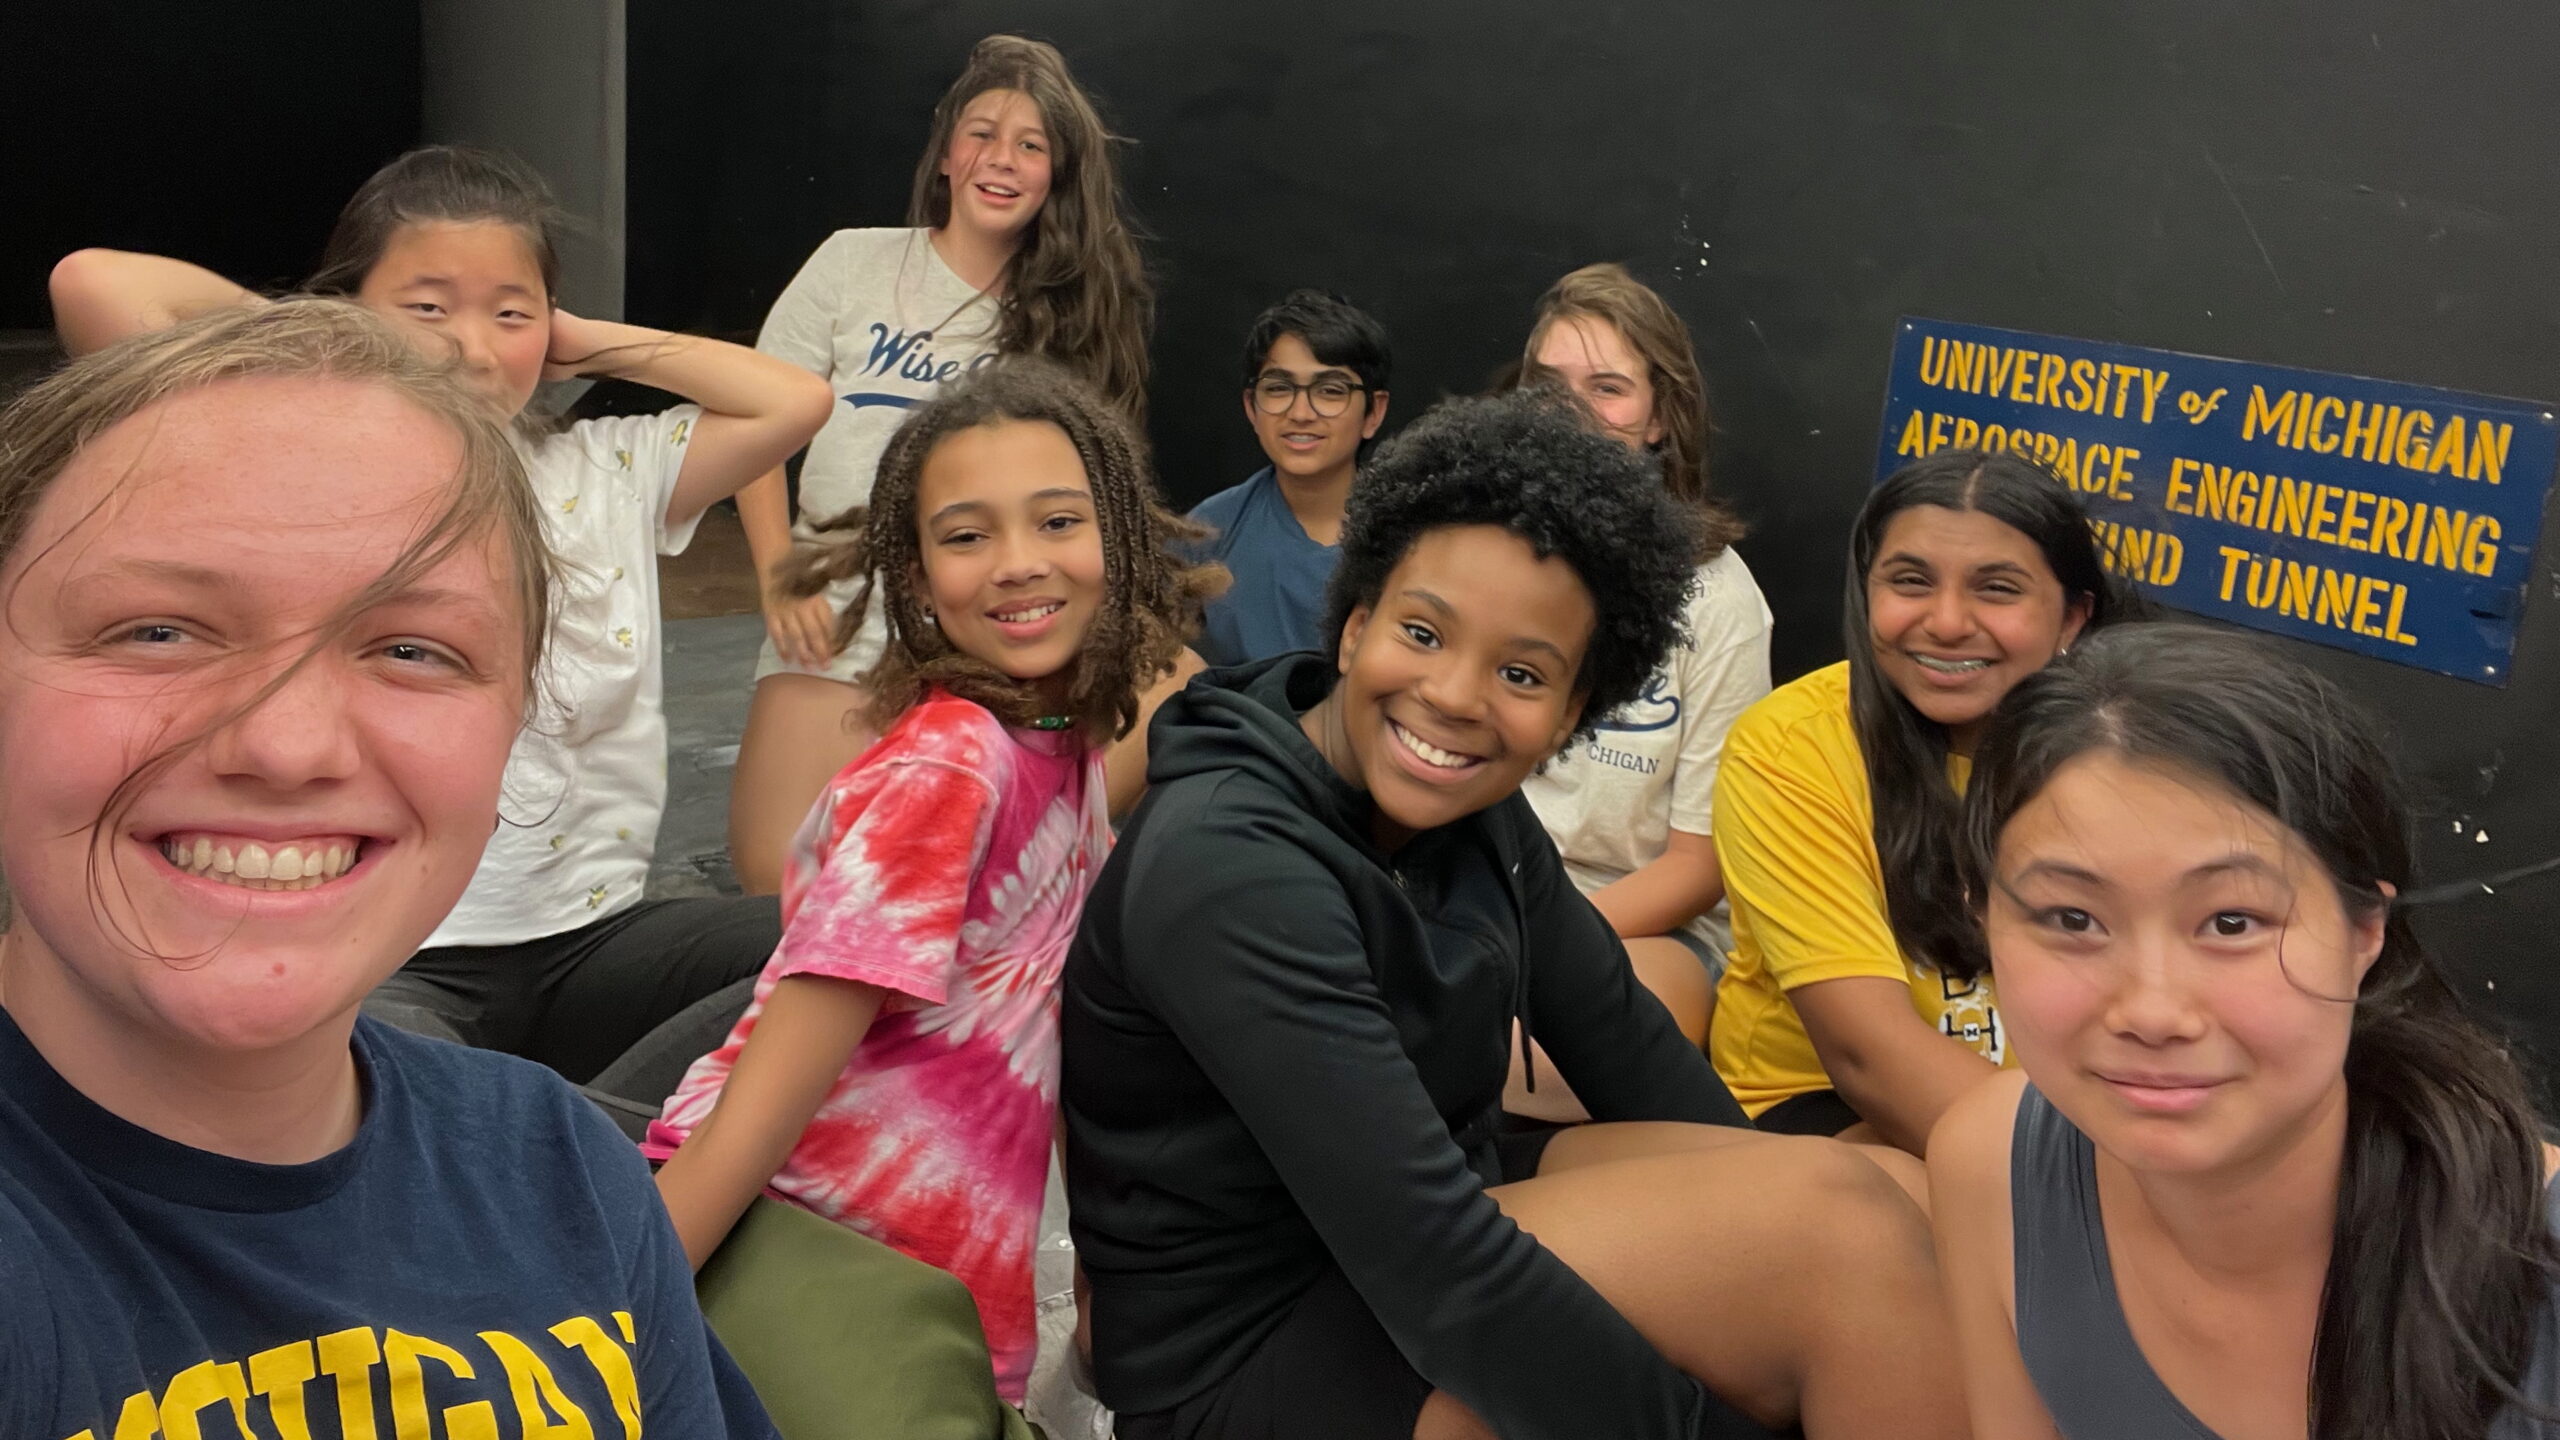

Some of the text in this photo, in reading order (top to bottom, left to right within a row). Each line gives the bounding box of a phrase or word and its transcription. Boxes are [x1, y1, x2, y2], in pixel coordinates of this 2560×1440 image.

[858, 322, 960, 382] Wise
[1920, 336, 2513, 485] UNIVERSITY of MICHIGAN
[2165, 457, 2502, 577] ENGINEERING
[2219, 546, 2418, 646] TUNNEL
[1588, 744, 1661, 775] CHIGAN
